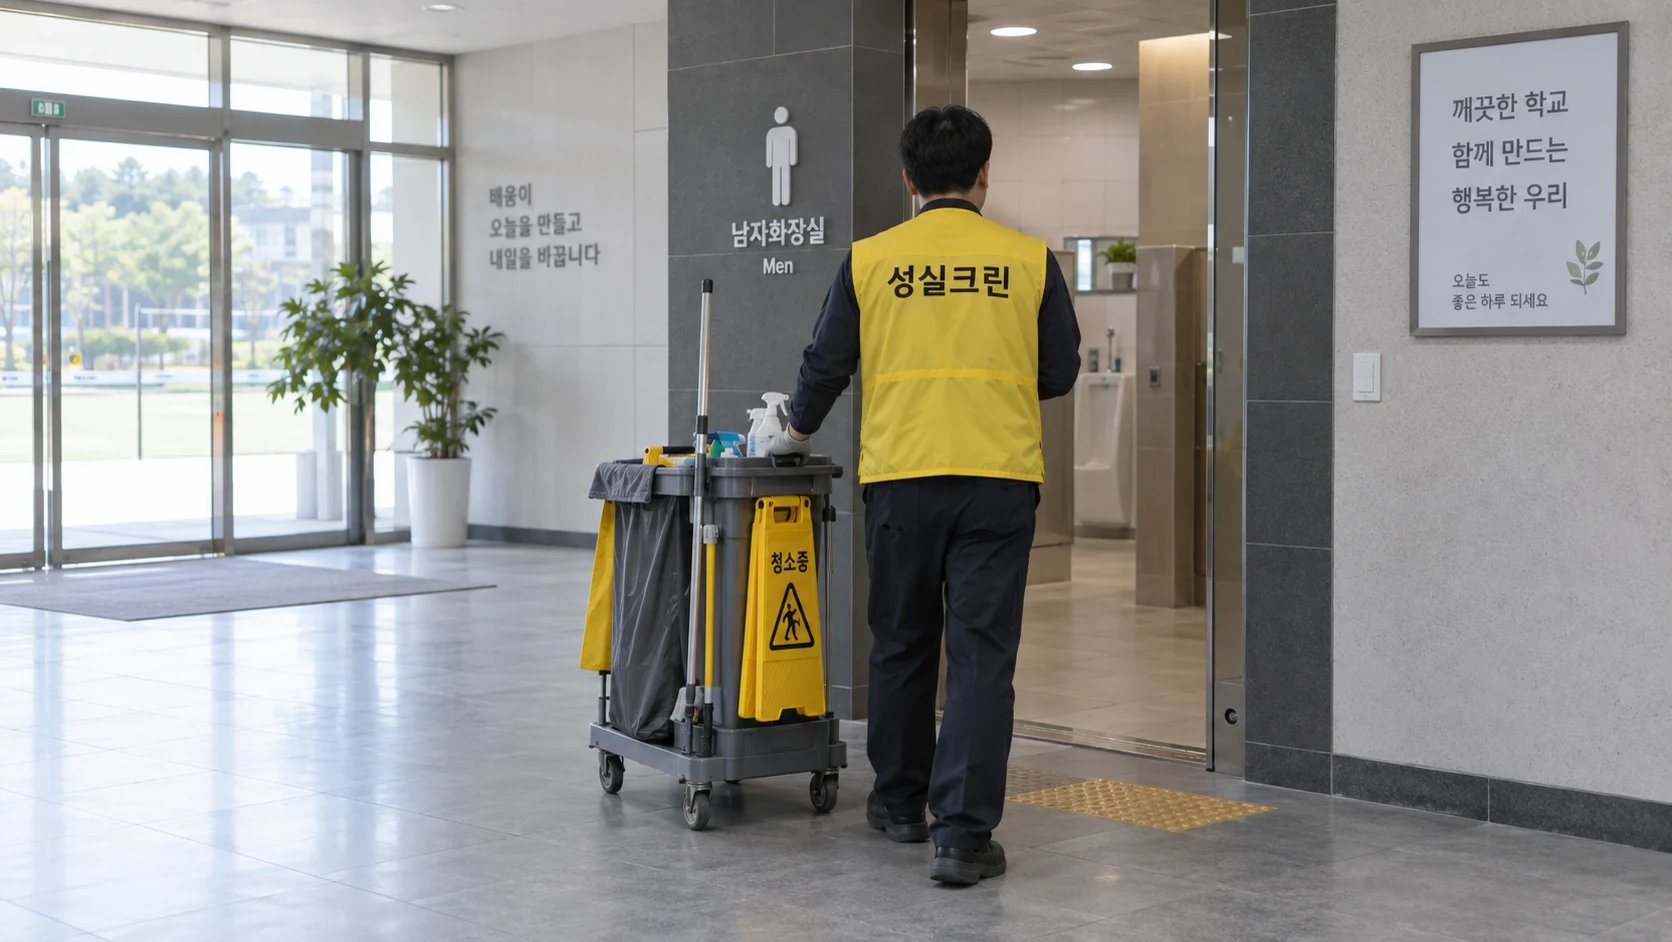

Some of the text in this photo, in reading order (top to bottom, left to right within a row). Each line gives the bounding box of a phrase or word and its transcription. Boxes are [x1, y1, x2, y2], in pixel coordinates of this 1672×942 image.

[1453, 91, 1569, 123] 깨끗한 학교
[1452, 137, 1569, 169] 함께 만드는
[489, 183, 532, 208] 배움이
[1452, 182, 1567, 214] 행복한 우리
[489, 212, 583, 239] 오늘을 만들고
[731, 216, 825, 248] 남자화장실
[489, 242, 601, 270] 내일을 바꿉니다
[763, 257, 794, 275] Men
[887, 264, 1010, 299] 성실크린
[1452, 273, 1490, 289] 오늘도
[1452, 292, 1549, 311] 좋은 하루 되세요
[771, 551, 809, 575] 청소중
